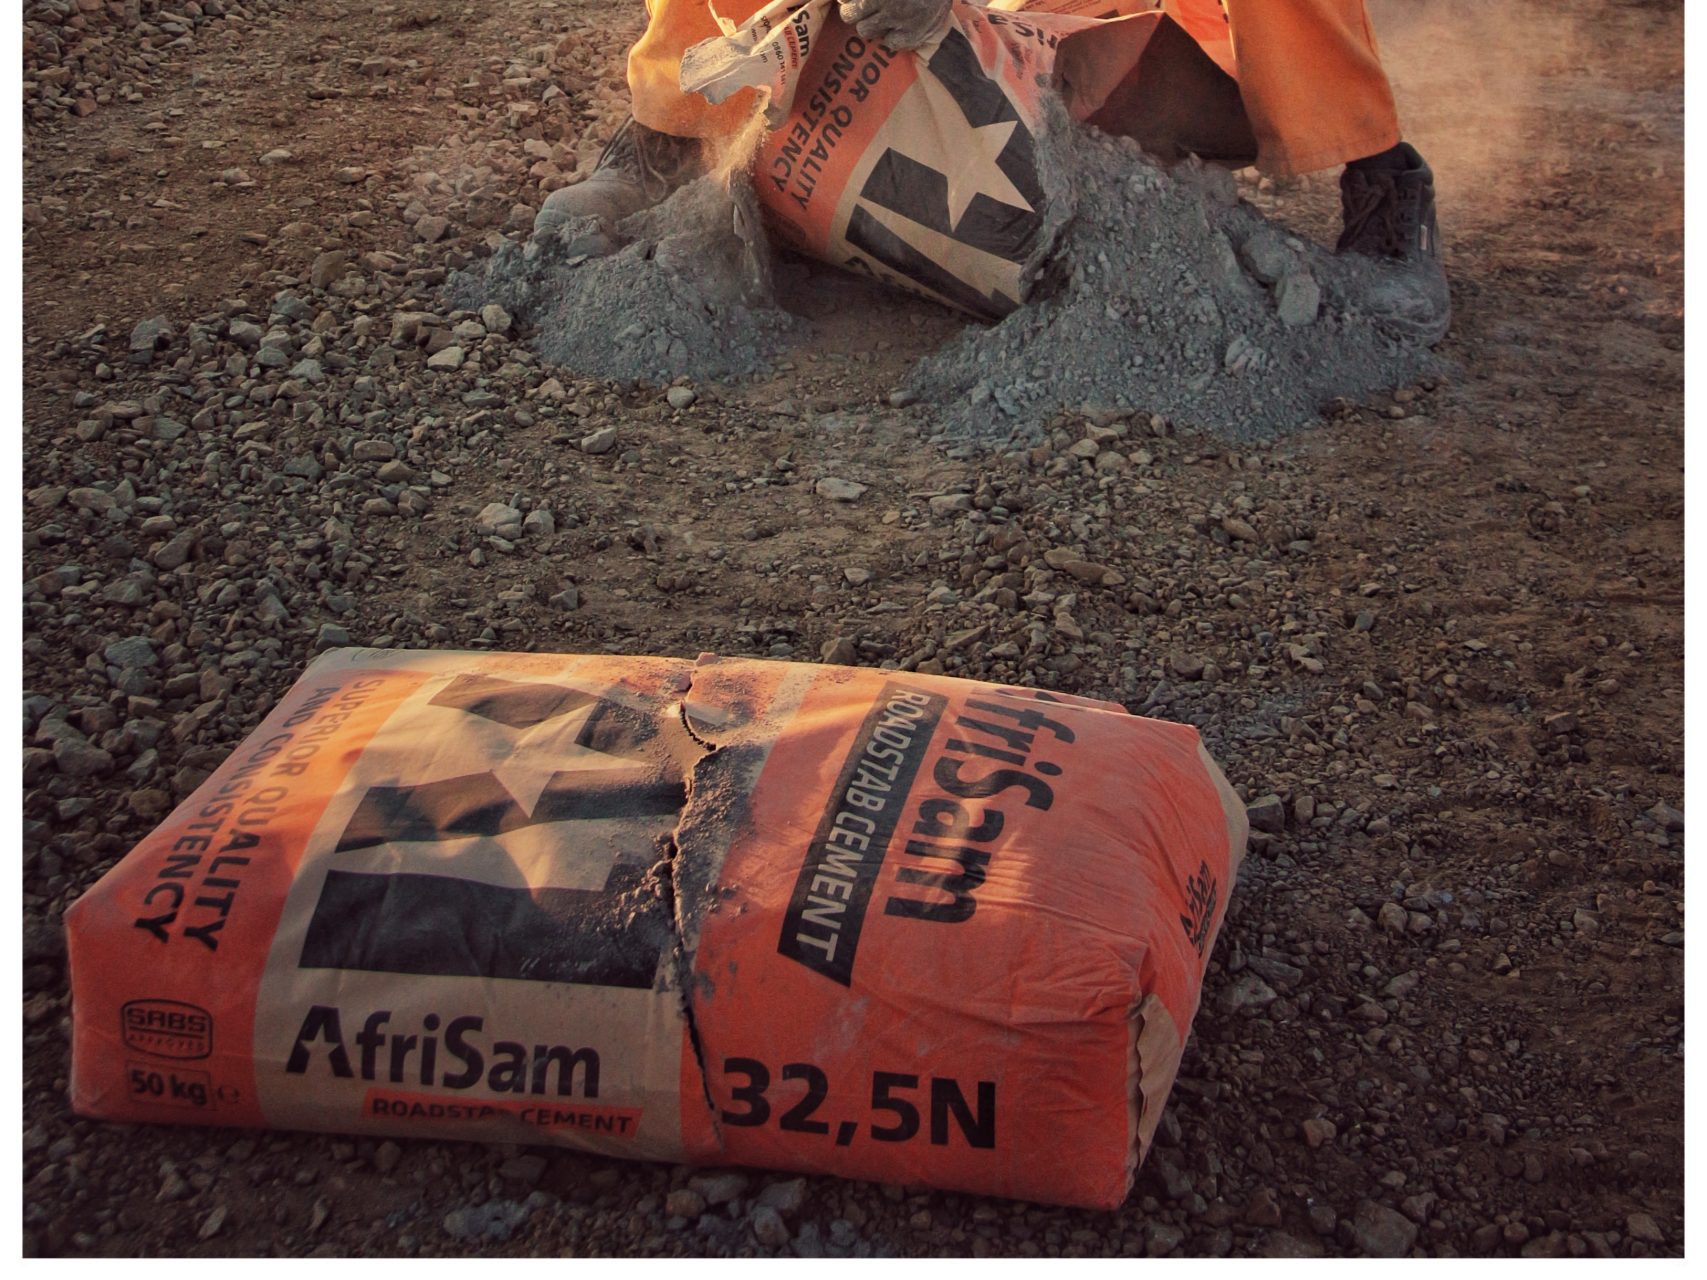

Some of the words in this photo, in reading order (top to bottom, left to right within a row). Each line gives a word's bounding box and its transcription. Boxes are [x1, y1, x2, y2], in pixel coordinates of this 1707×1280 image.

[770, 36, 866, 193] ONSISTENCY
[849, 44, 898, 103] RIOR
[791, 105, 853, 211] QUALITY
[269, 678, 385, 778] SUPERIOR
[281, 686, 340, 730] AND
[845, 689, 932, 812] ROADSTAB
[134, 732, 294, 944] CONSISTENCY
[183, 785, 290, 953] QUALITY
[796, 811, 876, 962] CEMENT
[126, 1007, 206, 1033] SABS
[286, 1005, 602, 1098] AfriSam
[131, 1070, 164, 1097] 50
[170, 1074, 208, 1107] kg
[520, 1108, 634, 1134] CEMENT
[720, 1057, 997, 1150] 32,5N
